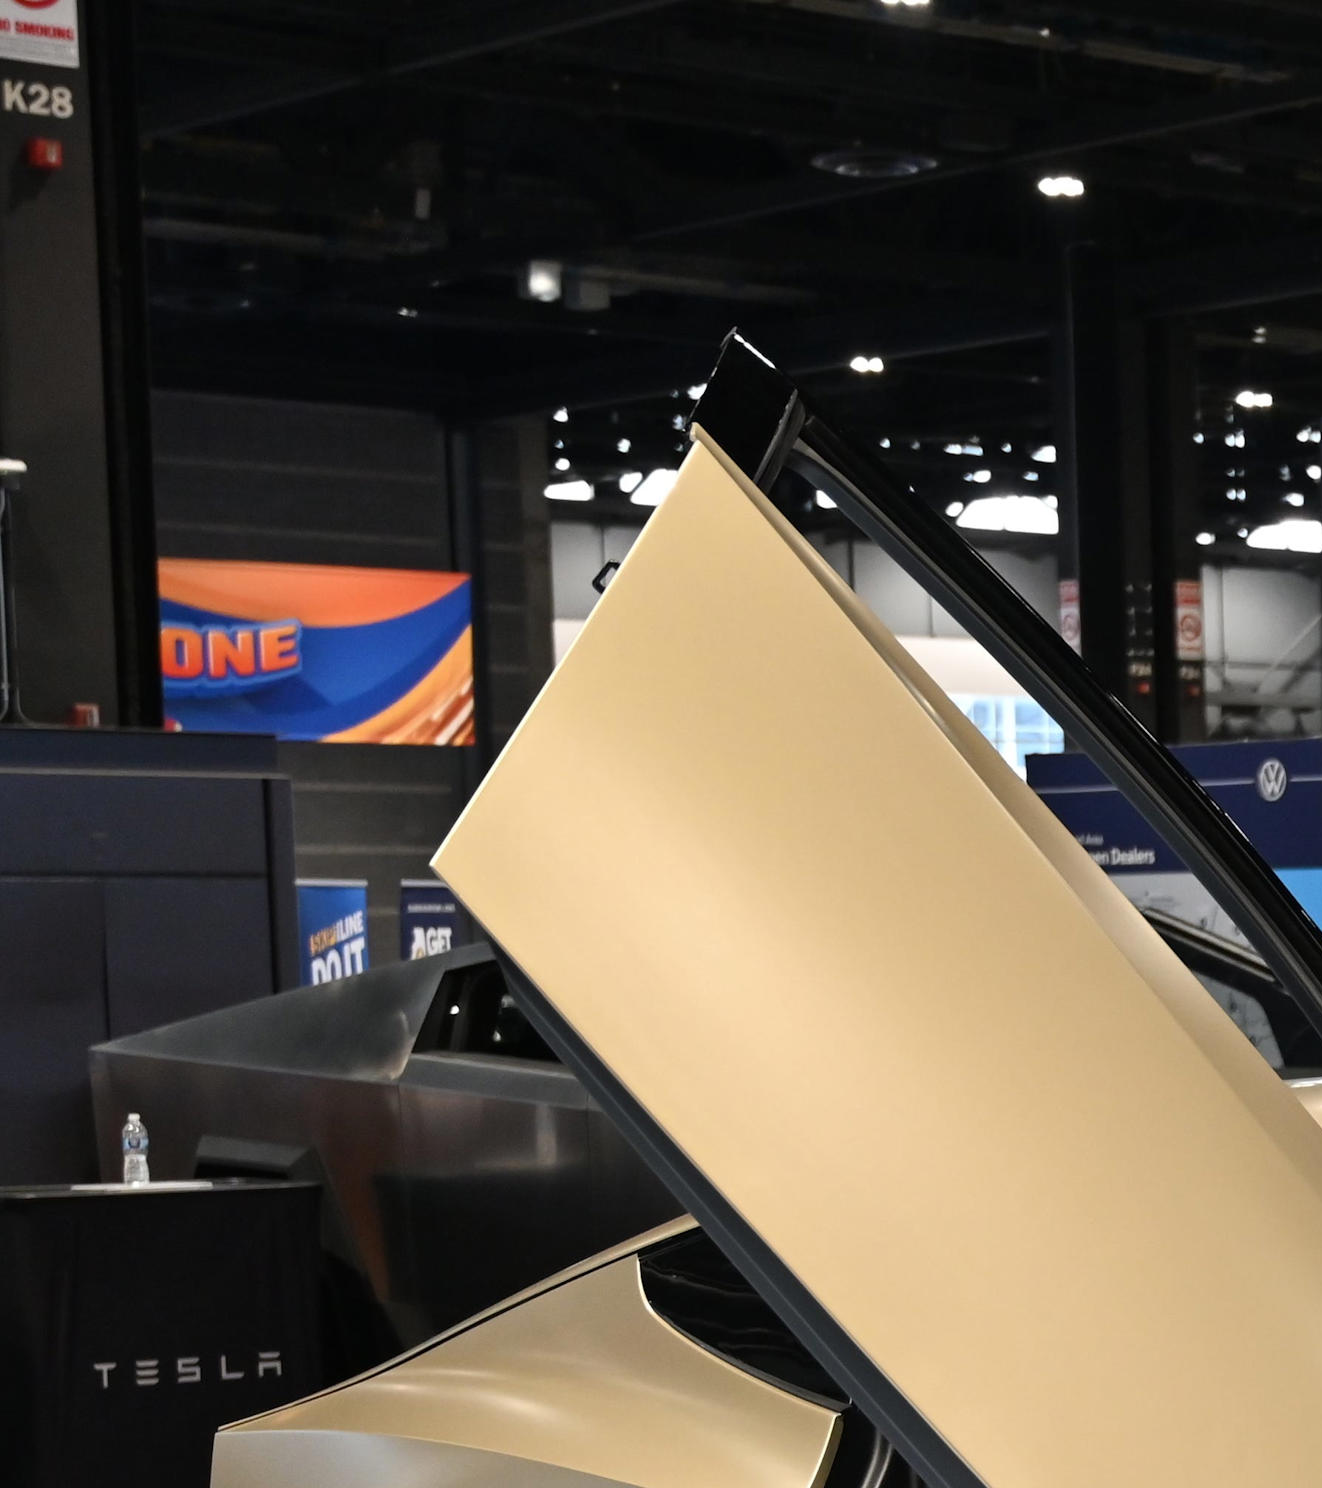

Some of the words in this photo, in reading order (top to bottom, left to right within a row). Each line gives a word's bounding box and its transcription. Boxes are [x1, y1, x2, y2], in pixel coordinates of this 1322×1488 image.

[15, 21, 75, 41] SMOKING
[3, 79, 74, 119] K28
[160, 624, 299, 678] ONE
[1110, 847, 1156, 865] Dealers
[343, 936, 365, 977] IT
[93, 1351, 283, 1389] TESLA
